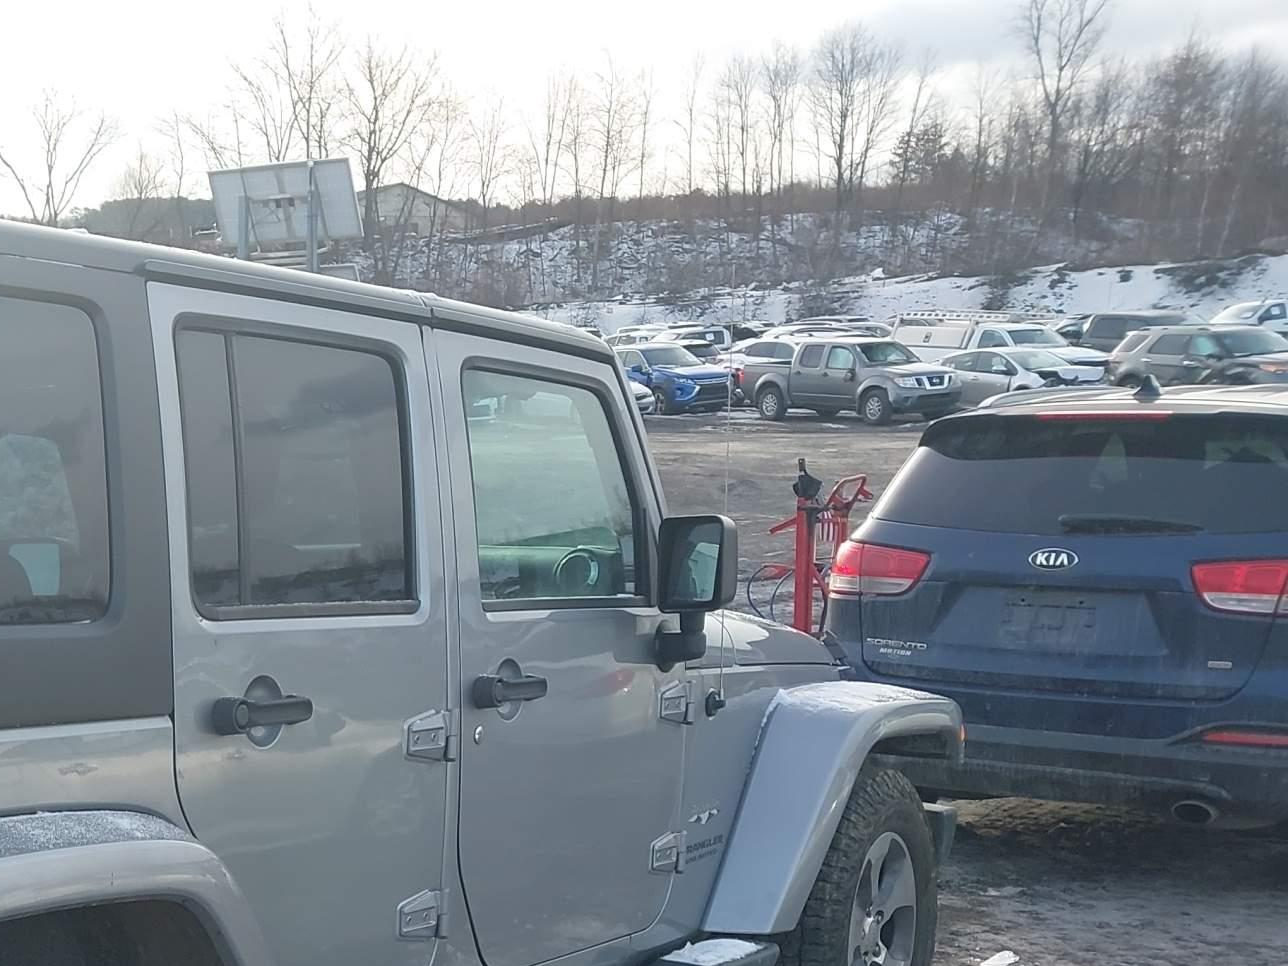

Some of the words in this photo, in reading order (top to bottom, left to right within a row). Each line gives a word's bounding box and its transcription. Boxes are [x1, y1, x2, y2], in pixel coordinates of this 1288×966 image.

[1036, 553, 1068, 566] KIA
[866, 637, 926, 650] SORENTO
[686, 834, 724, 854] RANGLER
